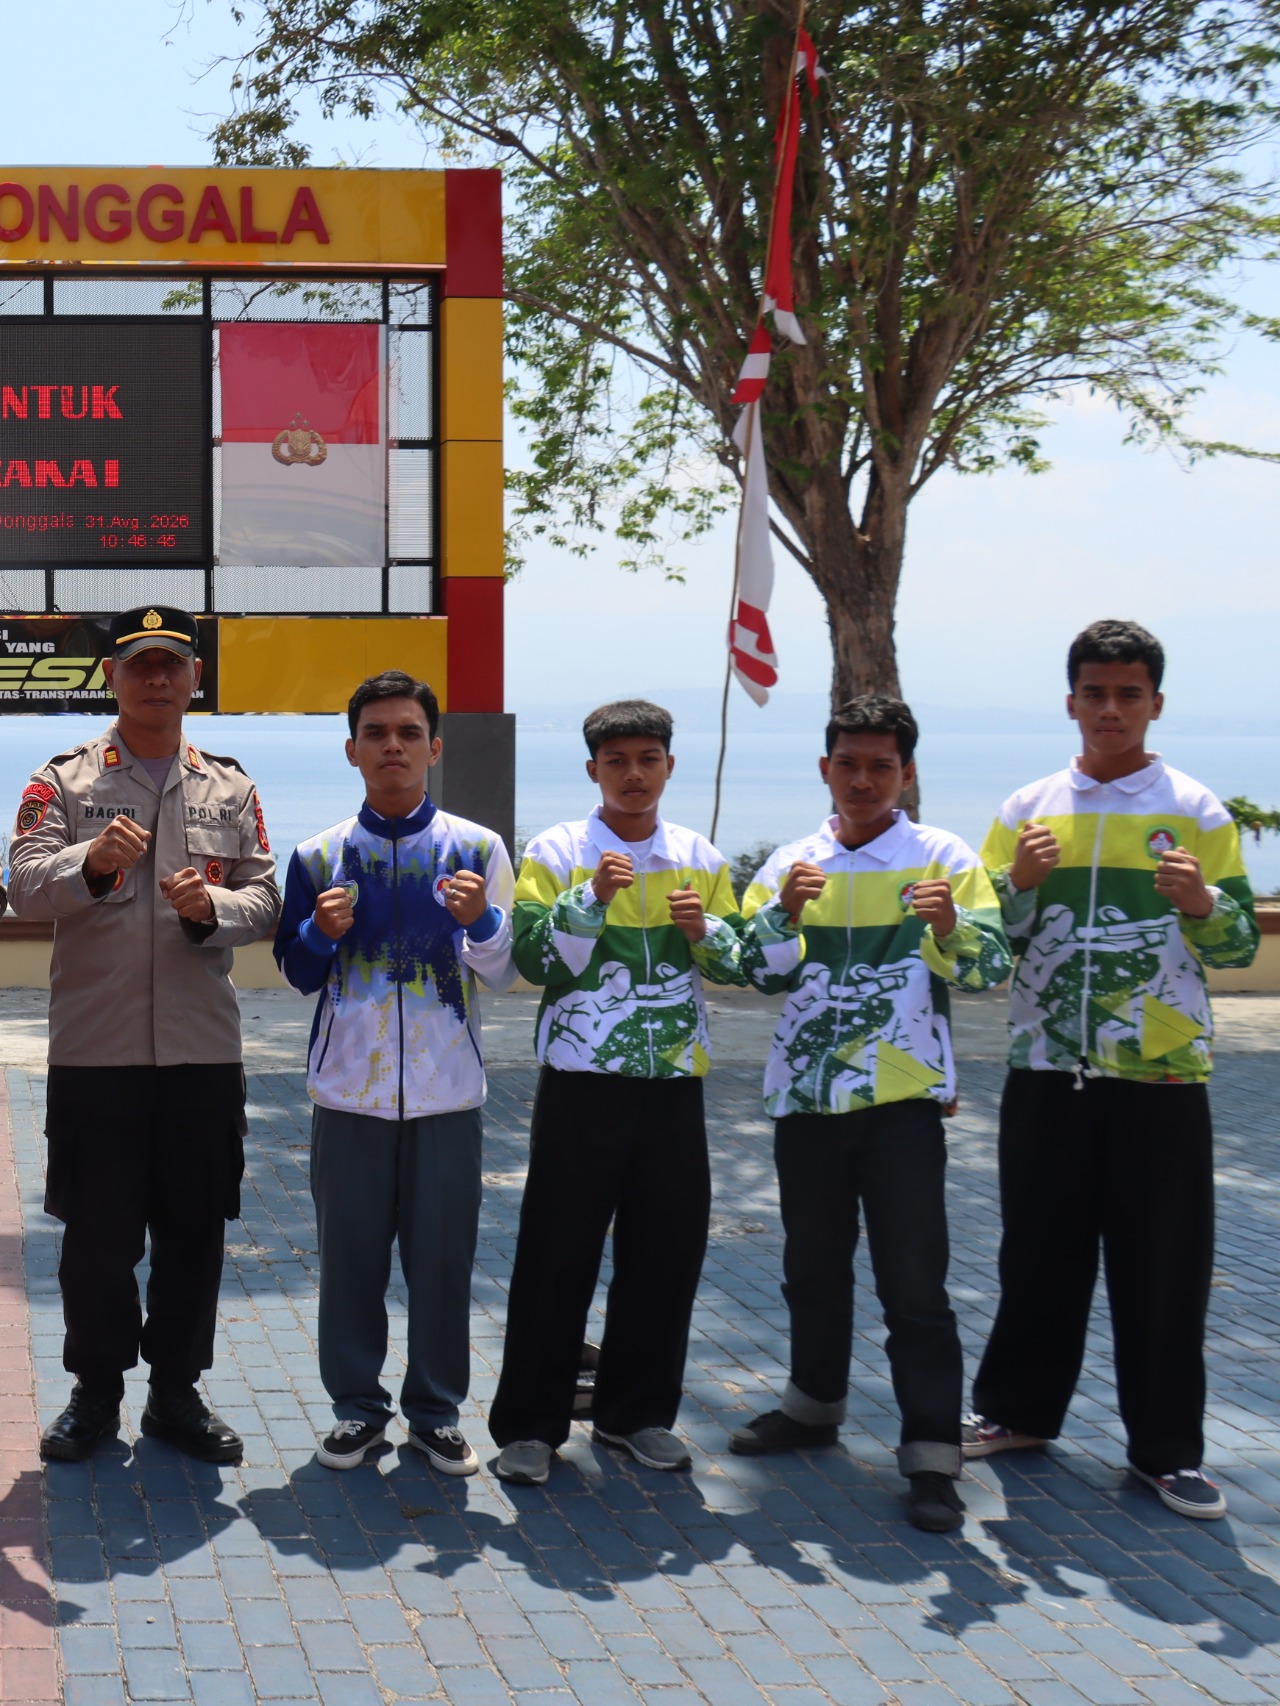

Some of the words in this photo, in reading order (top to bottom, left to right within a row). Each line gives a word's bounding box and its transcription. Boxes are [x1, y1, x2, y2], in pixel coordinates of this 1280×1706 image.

[5, 642, 55, 654] YANG
[85, 806, 135, 819] BAGIRI
[188, 806, 232, 821] POLRI
